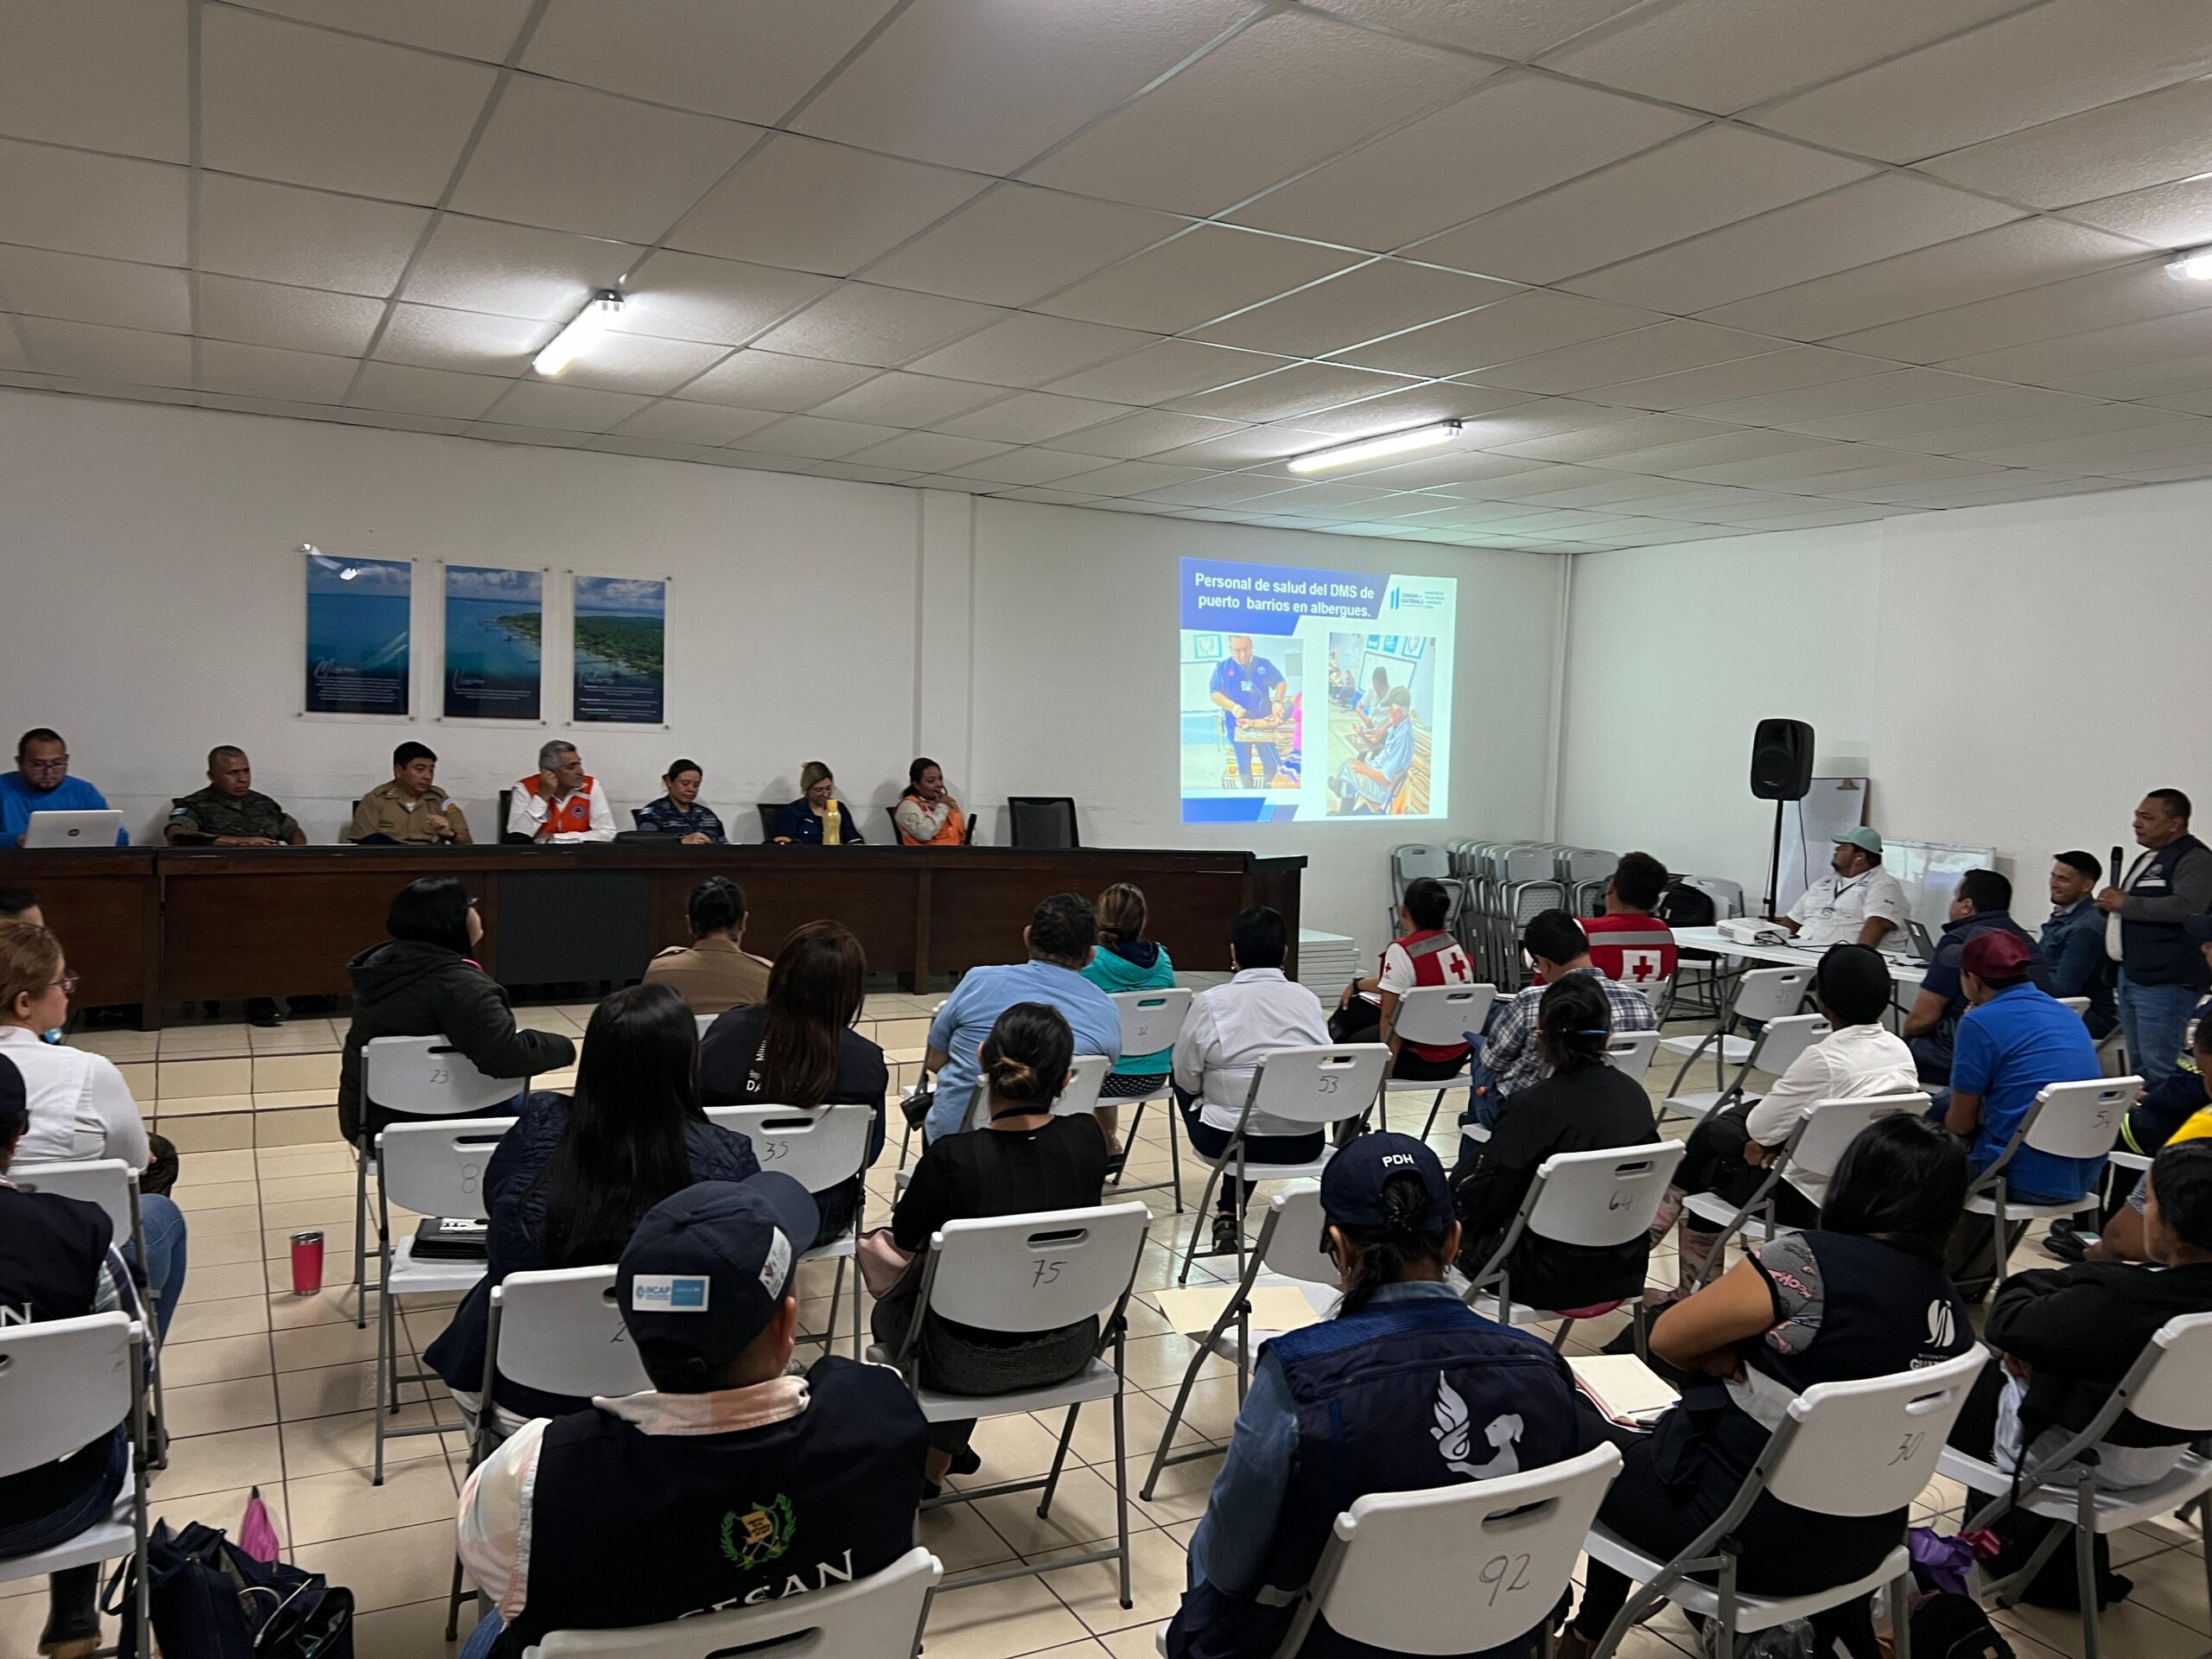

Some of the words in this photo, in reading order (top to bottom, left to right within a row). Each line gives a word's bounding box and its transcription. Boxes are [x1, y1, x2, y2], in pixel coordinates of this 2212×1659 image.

[1195, 572, 1251, 590] Personal
[1255, 578, 1270, 592] de
[1273, 580, 1306, 594] salud
[1309, 583, 1327, 596] del
[1330, 584, 1357, 599] DMS
[1360, 586, 1375, 600] de
[1198, 595, 1240, 609] puerto
[1246, 596, 1290, 613] barrios
[1293, 601, 1307, 613] en
[1310, 601, 1372, 619] albergues.
[761, 1141, 789, 1162] 35
[1382, 1154, 1415, 1167] PDH
[1033, 1259, 1070, 1288] 75
[1479, 1554, 1530, 1607] 92
